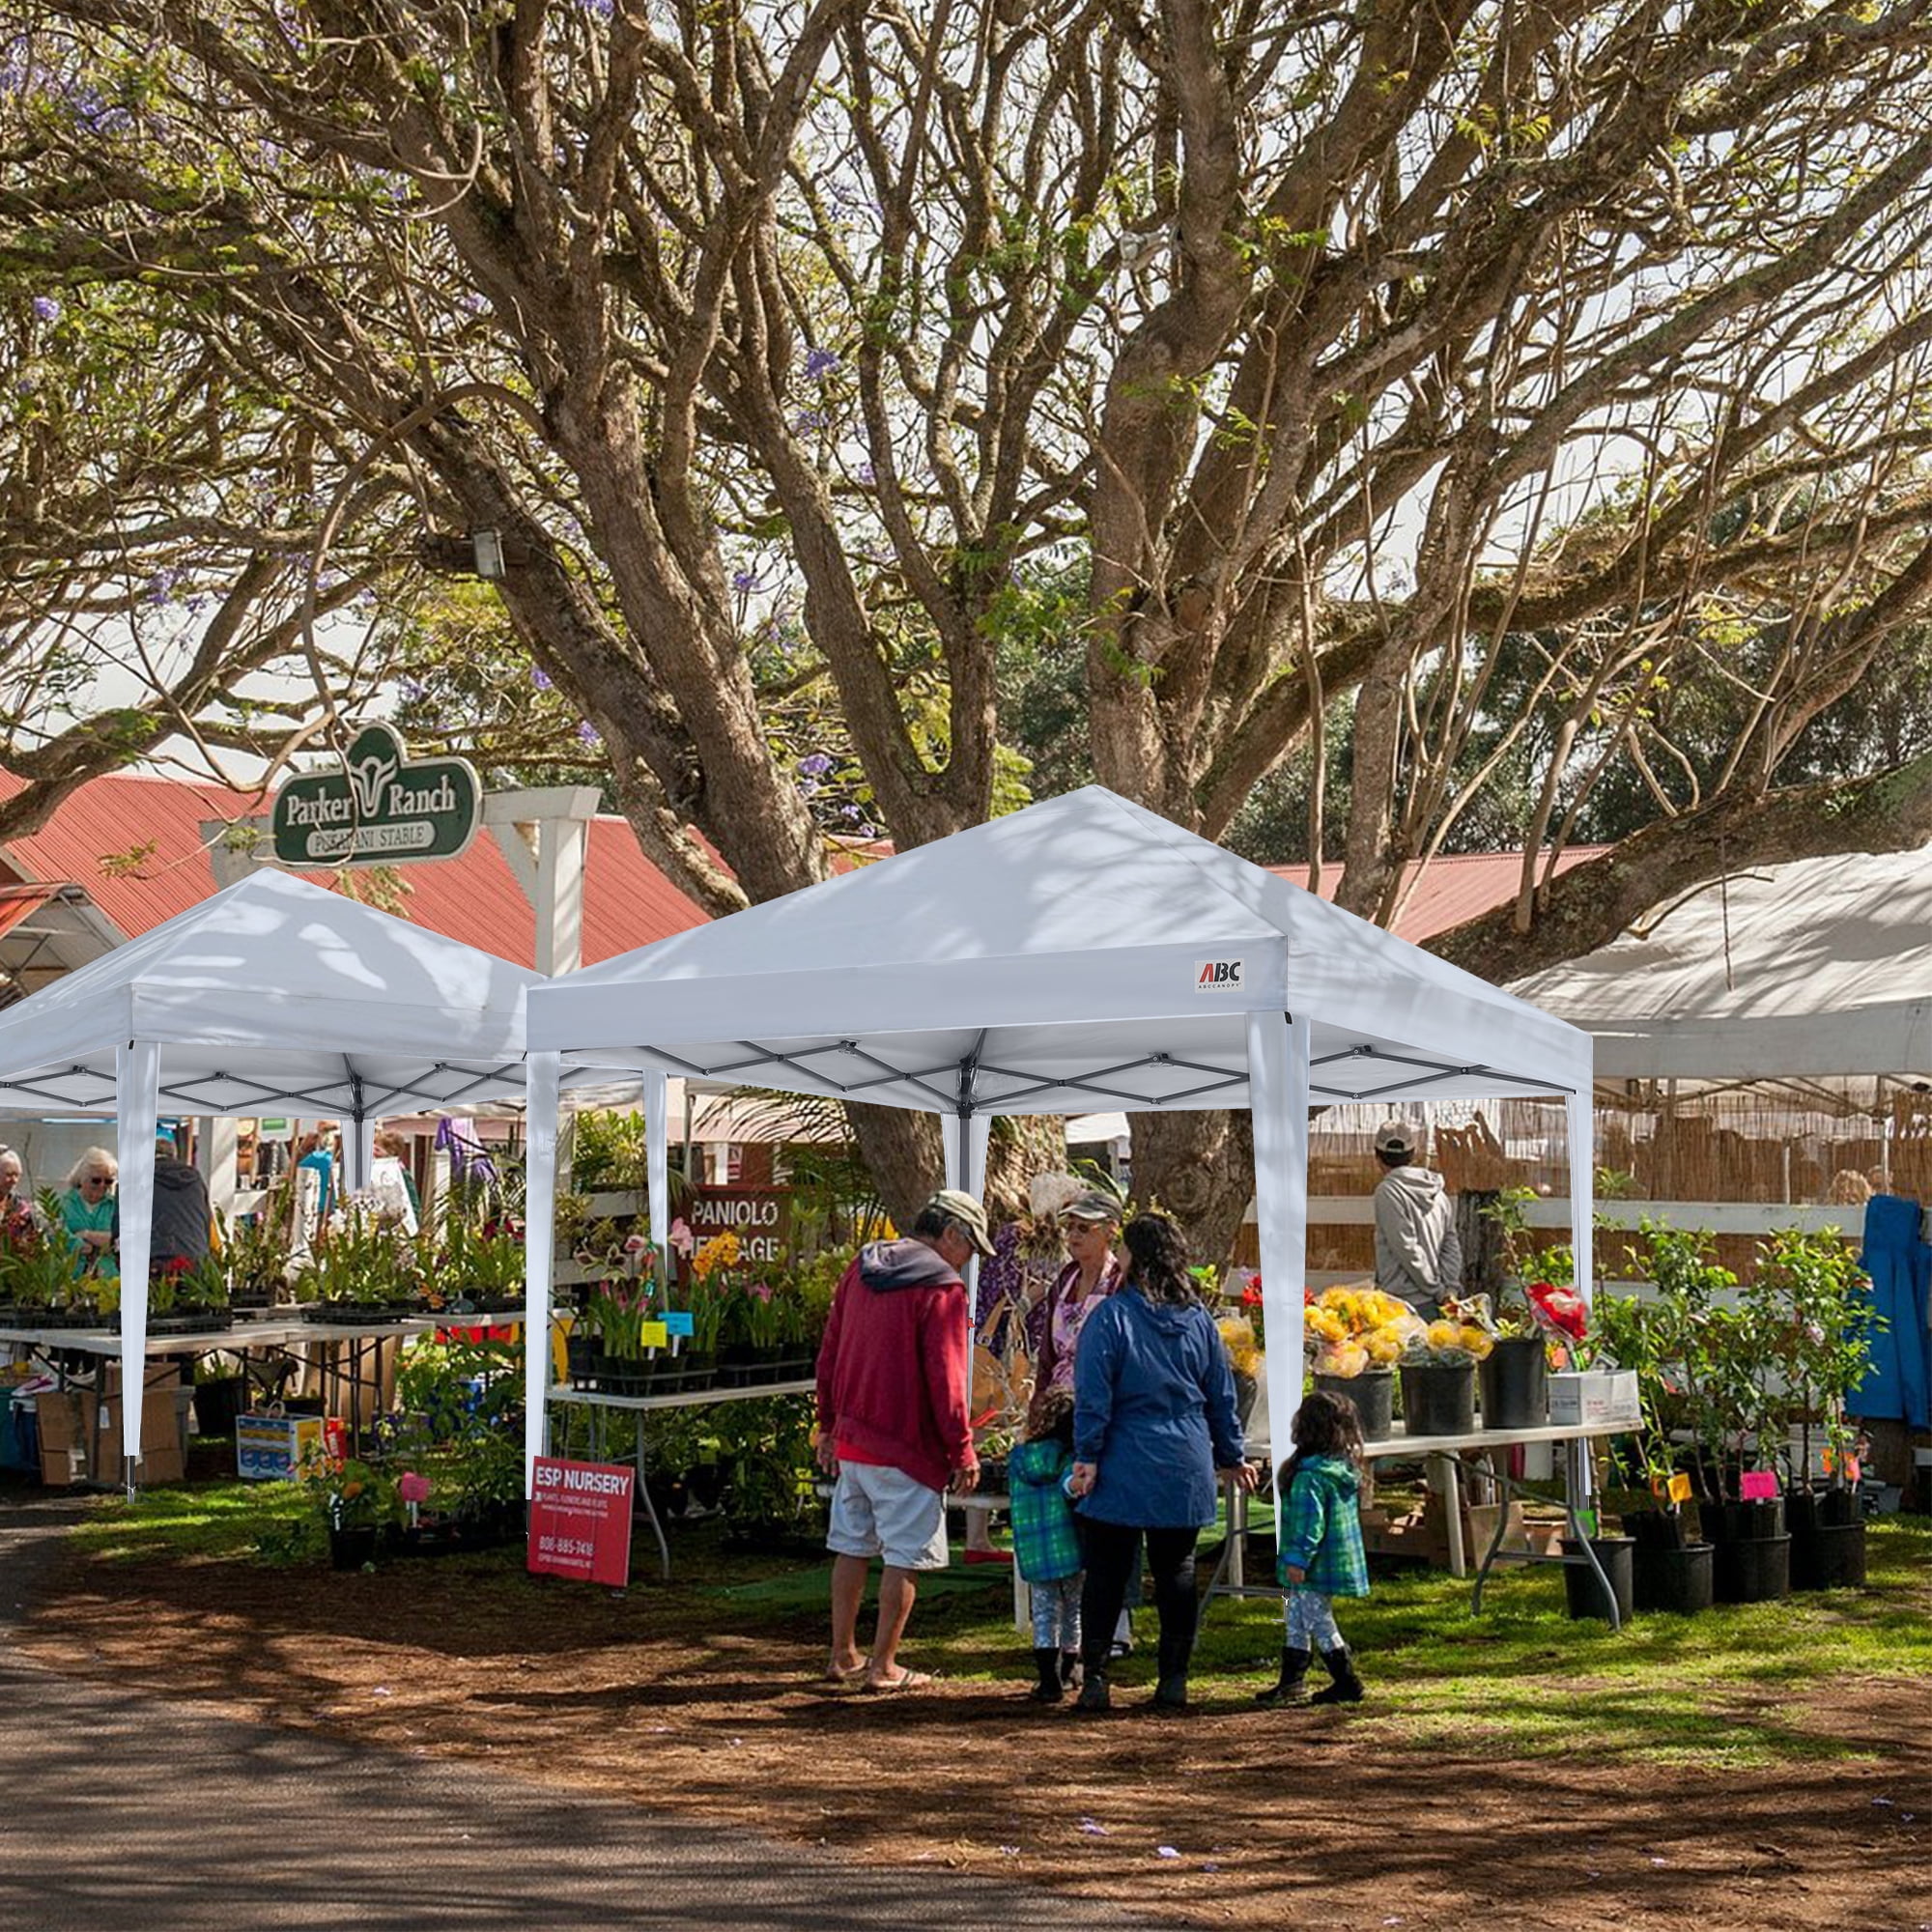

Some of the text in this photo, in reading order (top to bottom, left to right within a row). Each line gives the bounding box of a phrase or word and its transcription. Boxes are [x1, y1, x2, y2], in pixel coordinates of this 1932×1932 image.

[286, 774, 457, 826] Parker Ranch
[380, 826, 425, 847] STABLE
[1199, 961, 1241, 982] ABC
[691, 1200, 779, 1226] PANIOLO
[535, 1465, 630, 1496] ESP NURSERY
